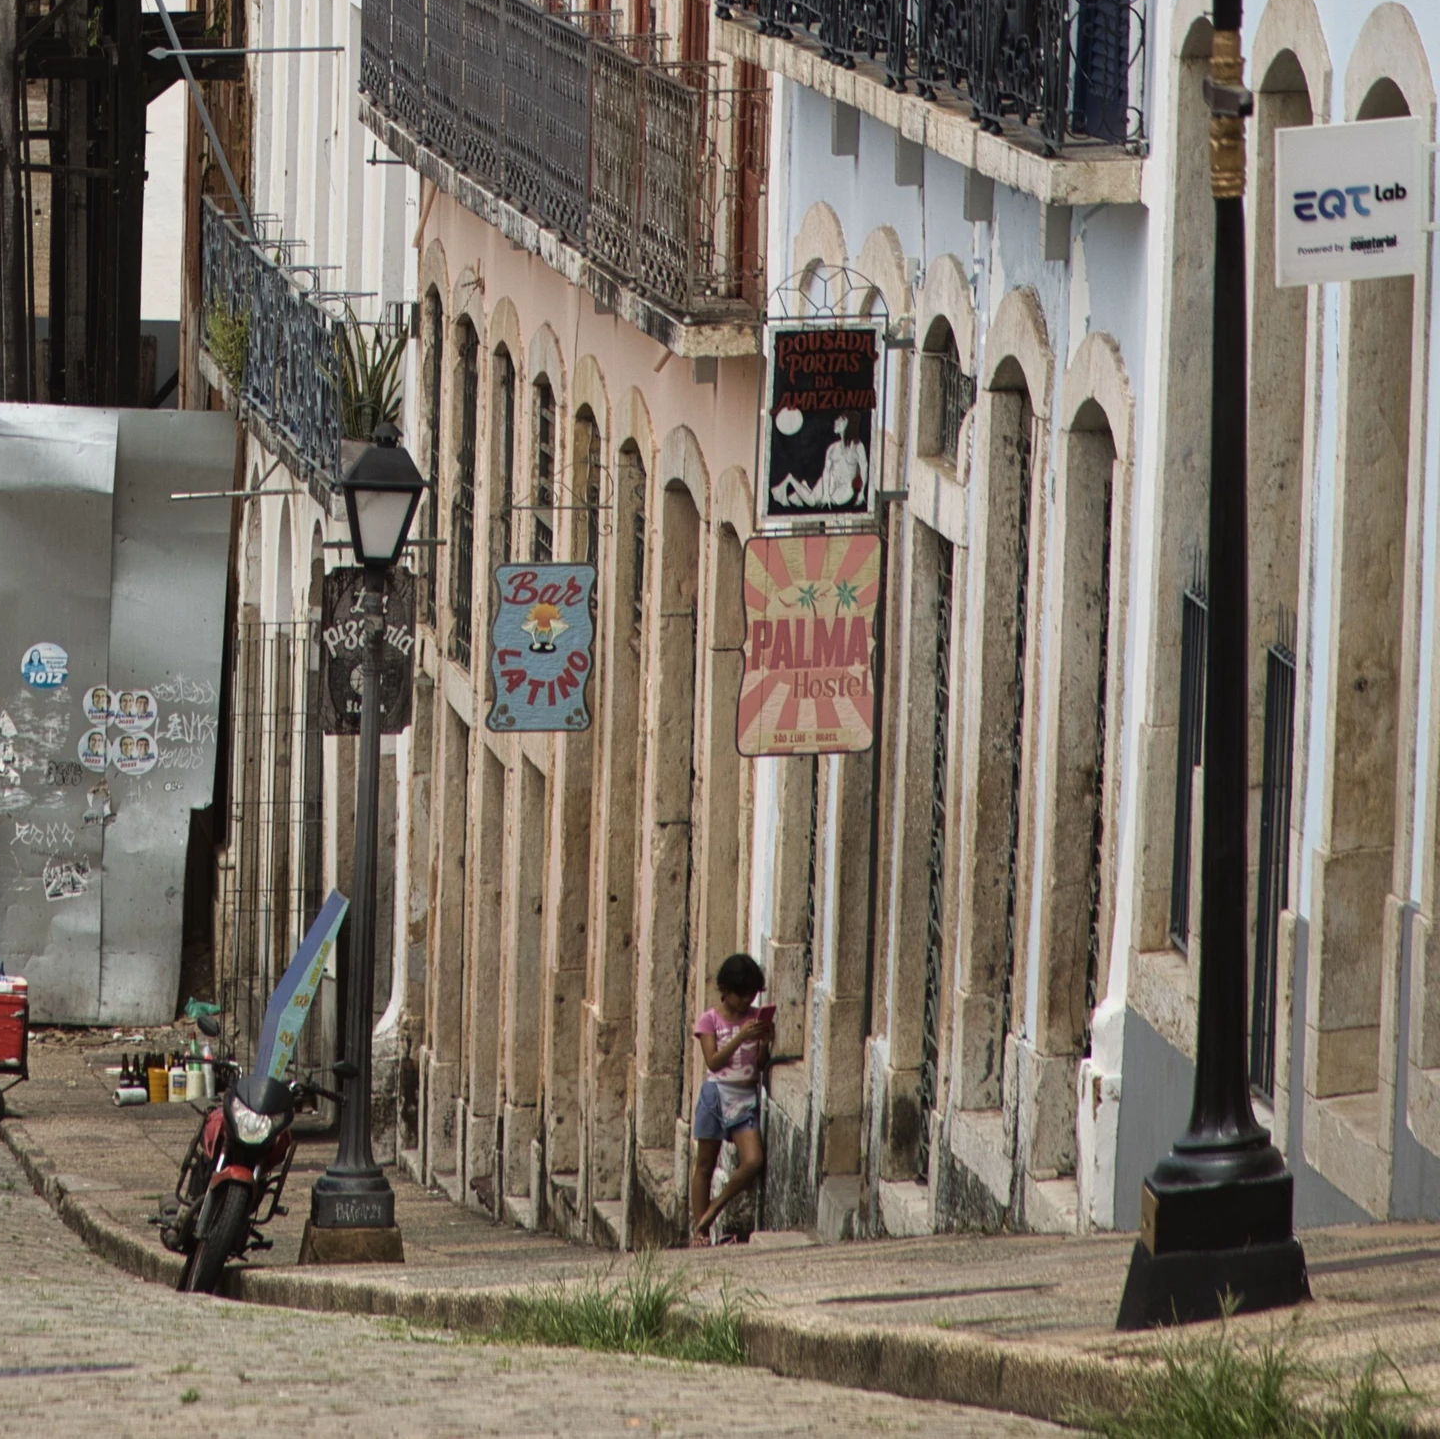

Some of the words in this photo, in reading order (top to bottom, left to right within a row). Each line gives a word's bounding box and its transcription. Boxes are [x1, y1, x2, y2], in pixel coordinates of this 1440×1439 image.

[1293, 184, 1371, 222] EQT
[1374, 182, 1407, 202] lab
[1297, 243, 1334, 256] Powered
[1335, 243, 1345, 254] by
[777, 331, 879, 370] POUSADA
[786, 352, 862, 385] PORTAS
[815, 375, 833, 388] DA
[770, 386, 877, 416] AMAZÔNIA
[503, 571, 584, 607] Bar
[751, 616, 869, 670] PALMA
[29, 672, 63, 684] 1012
[497, 648, 589, 707] LATINO
[793, 668, 869, 699] Hostel
[815, 731, 839, 743] BRASIL
